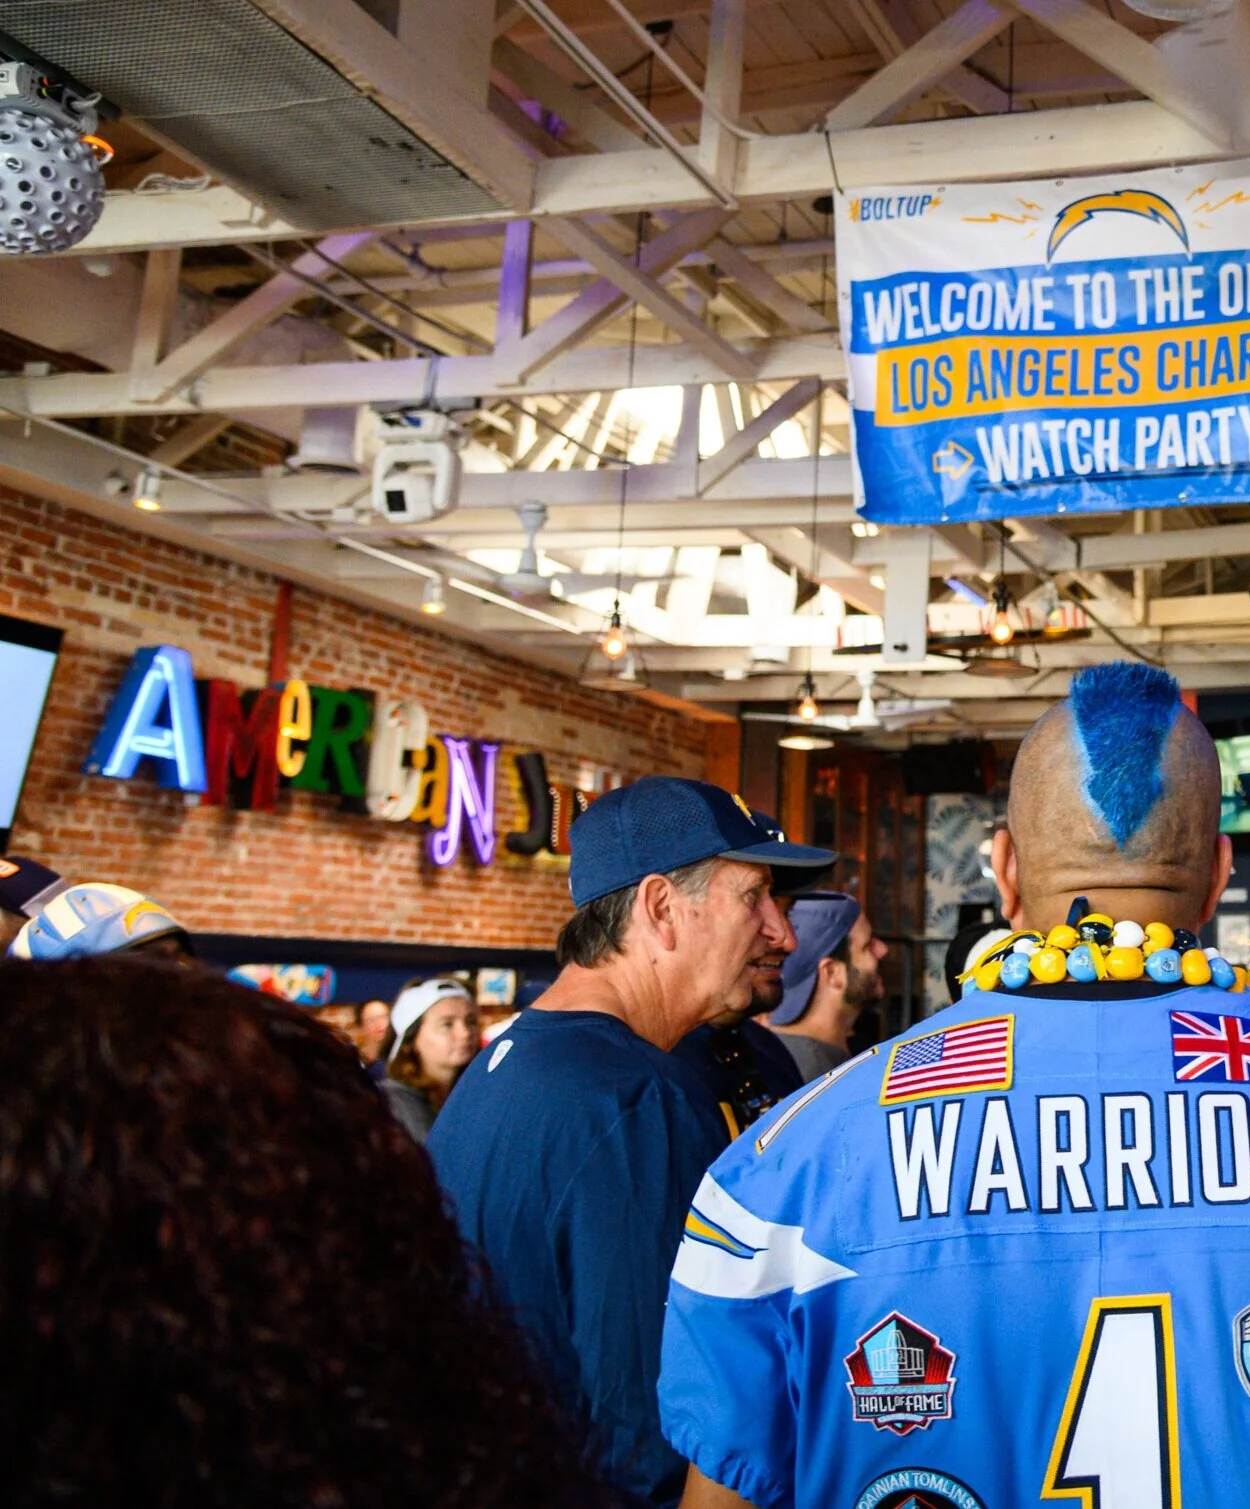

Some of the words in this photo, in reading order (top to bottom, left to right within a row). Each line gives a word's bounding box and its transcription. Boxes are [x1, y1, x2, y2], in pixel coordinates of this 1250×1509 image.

[863, 281, 1055, 345] WELCOME
[1066, 275, 1118, 330] TO
[1134, 266, 1205, 326] THE
[891, 355, 954, 415] LOS
[966, 344, 1141, 404] ANGELES
[975, 417, 1120, 484] WATCH
[860, 1395, 896, 1413] HALL
[895, 1395, 905, 1407] OF
[905, 1393, 944, 1412] FAME
[1041, 1293, 1182, 1509] 1
